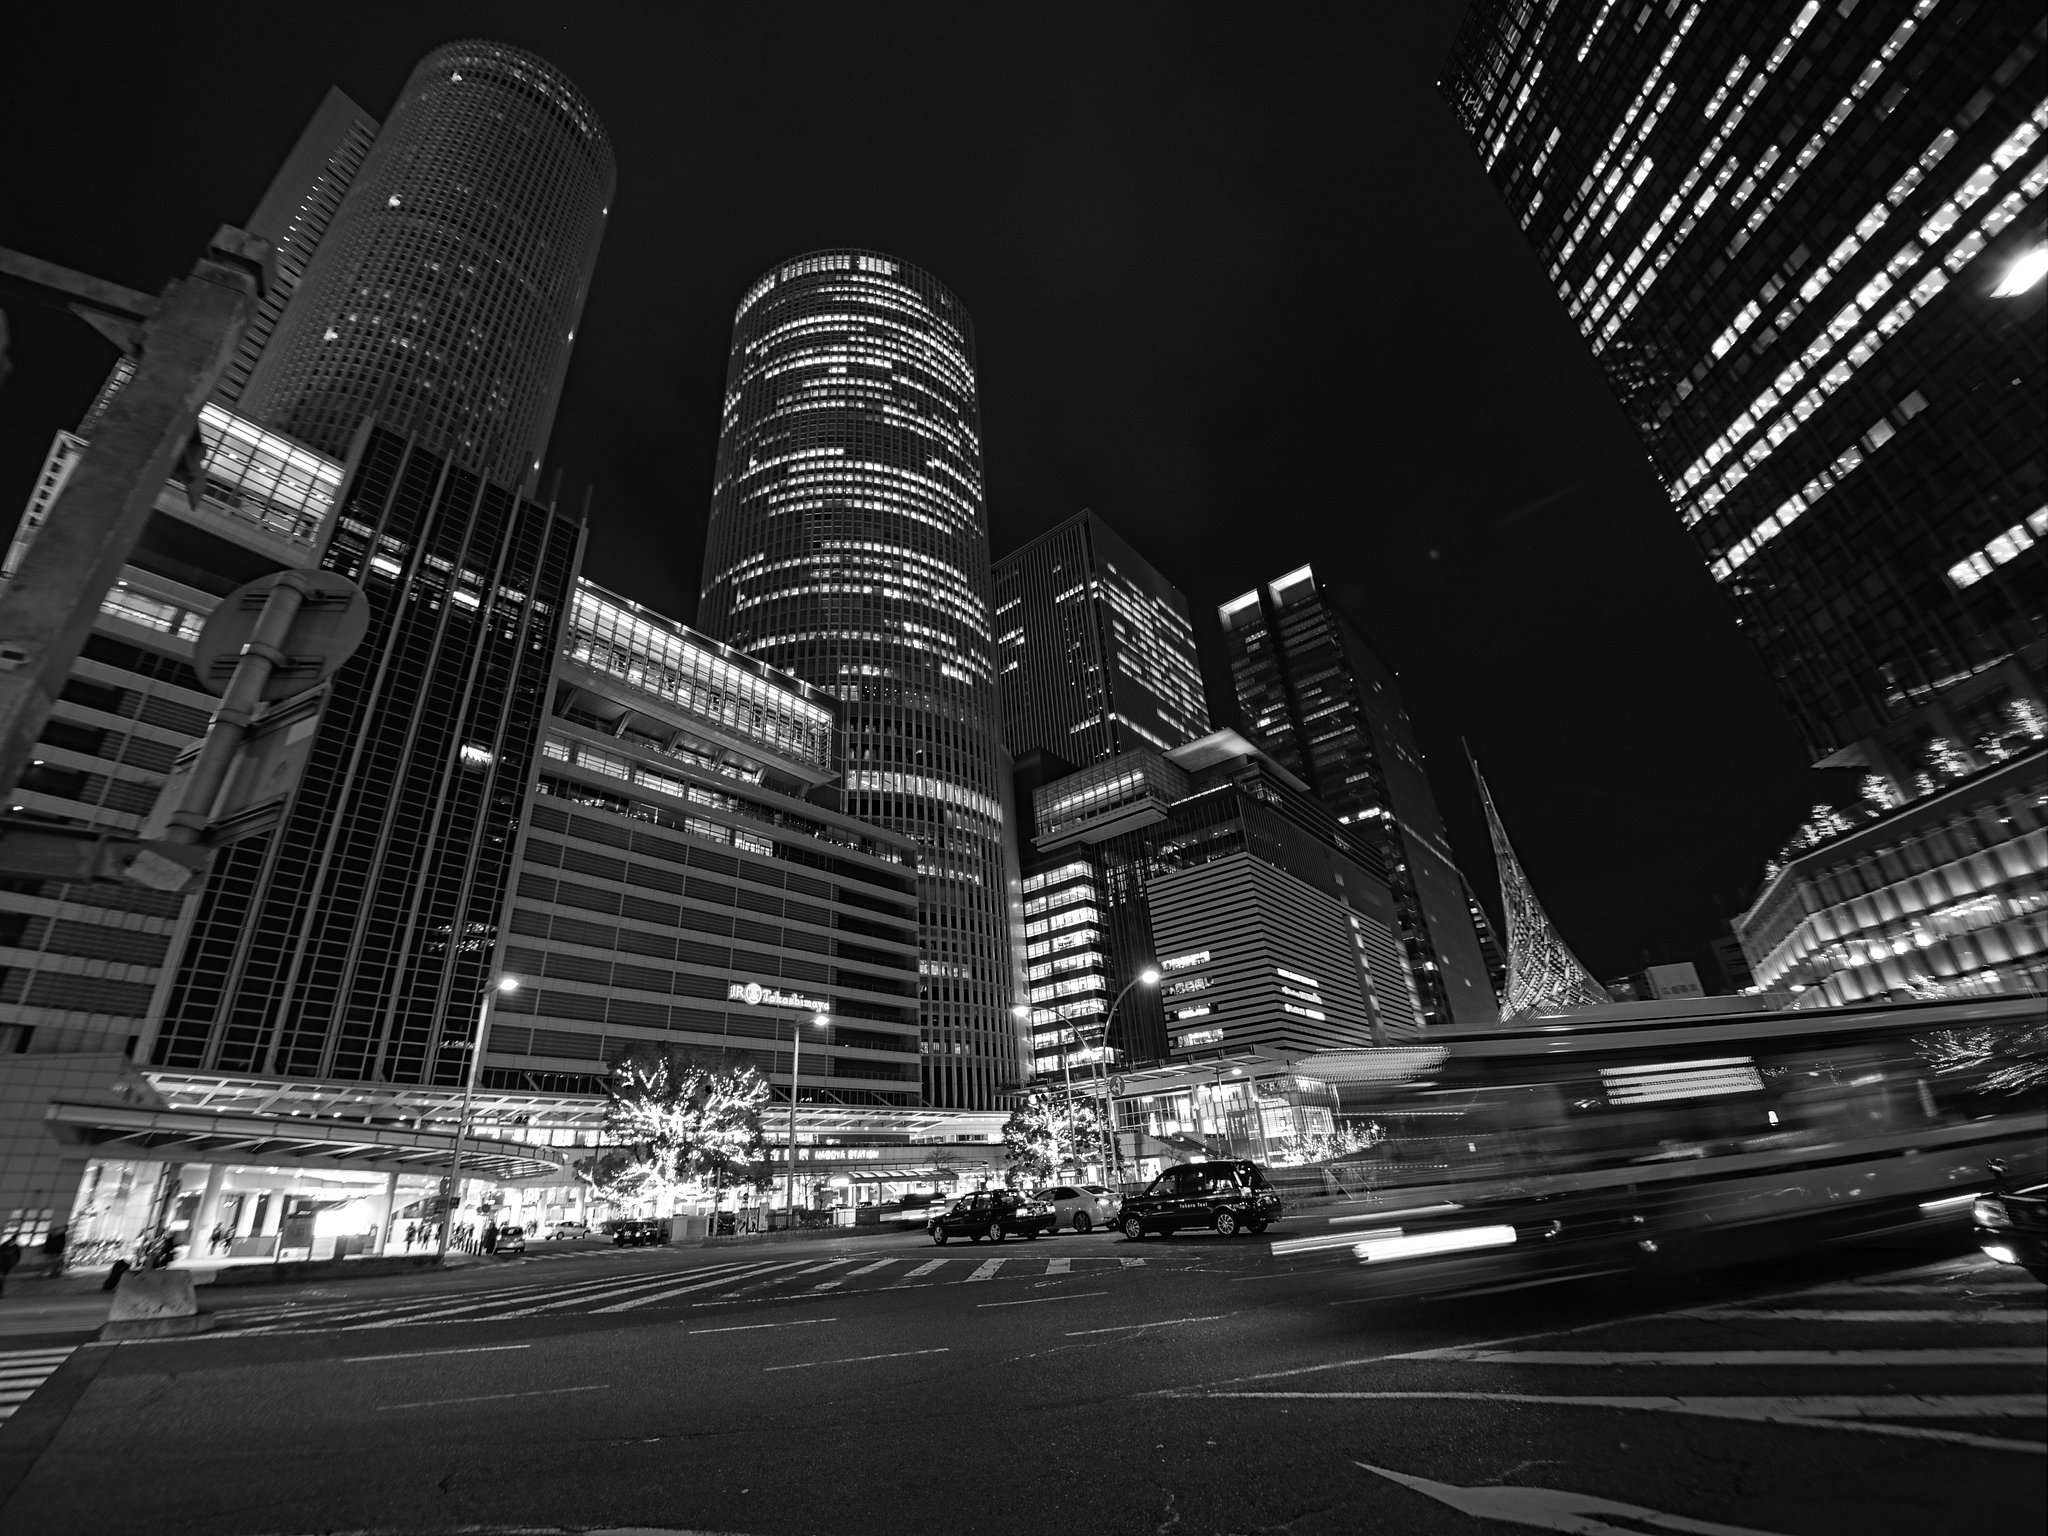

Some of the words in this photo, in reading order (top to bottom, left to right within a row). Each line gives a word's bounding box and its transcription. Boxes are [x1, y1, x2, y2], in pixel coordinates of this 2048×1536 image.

[730, 984, 745, 999] JR
[762, 989, 830, 1012] Takashimaya
[848, 1149, 880, 1160] STATION
